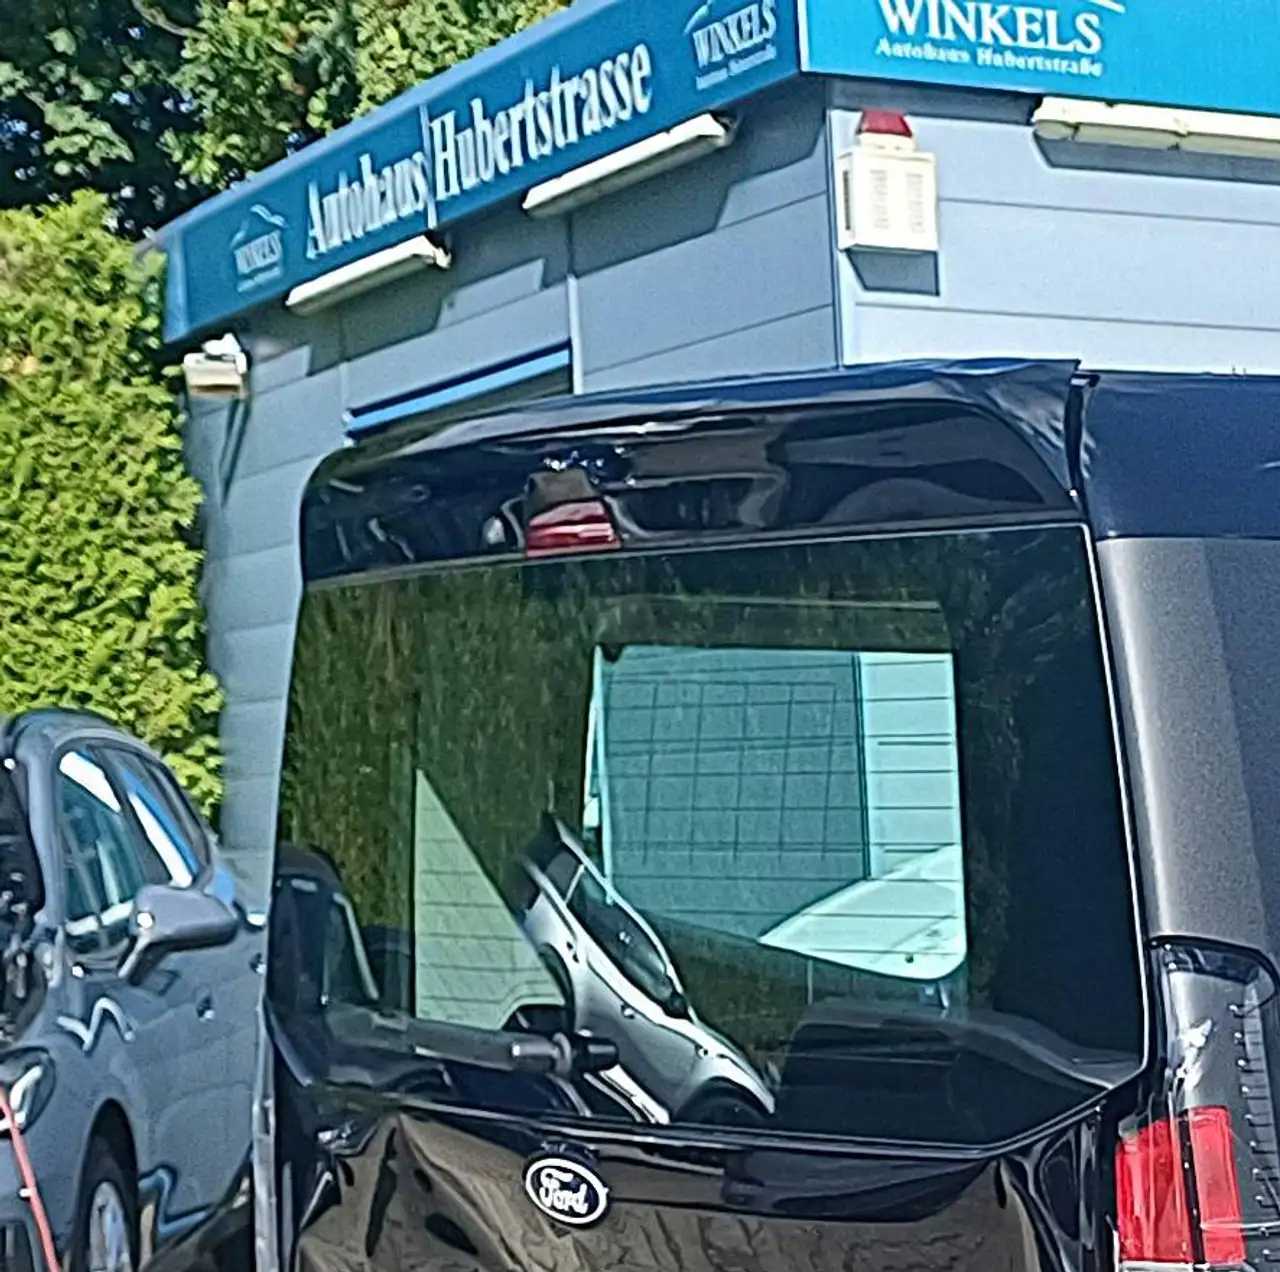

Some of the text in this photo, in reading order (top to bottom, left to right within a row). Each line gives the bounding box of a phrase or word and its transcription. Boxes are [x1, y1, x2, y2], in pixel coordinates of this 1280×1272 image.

[692, 1, 777, 68] WINKELS
[876, 0, 1103, 53] WINKELS
[306, 43, 653, 258] Autohaus Hubertstrasse
[537, 1167, 592, 1216] Ford
